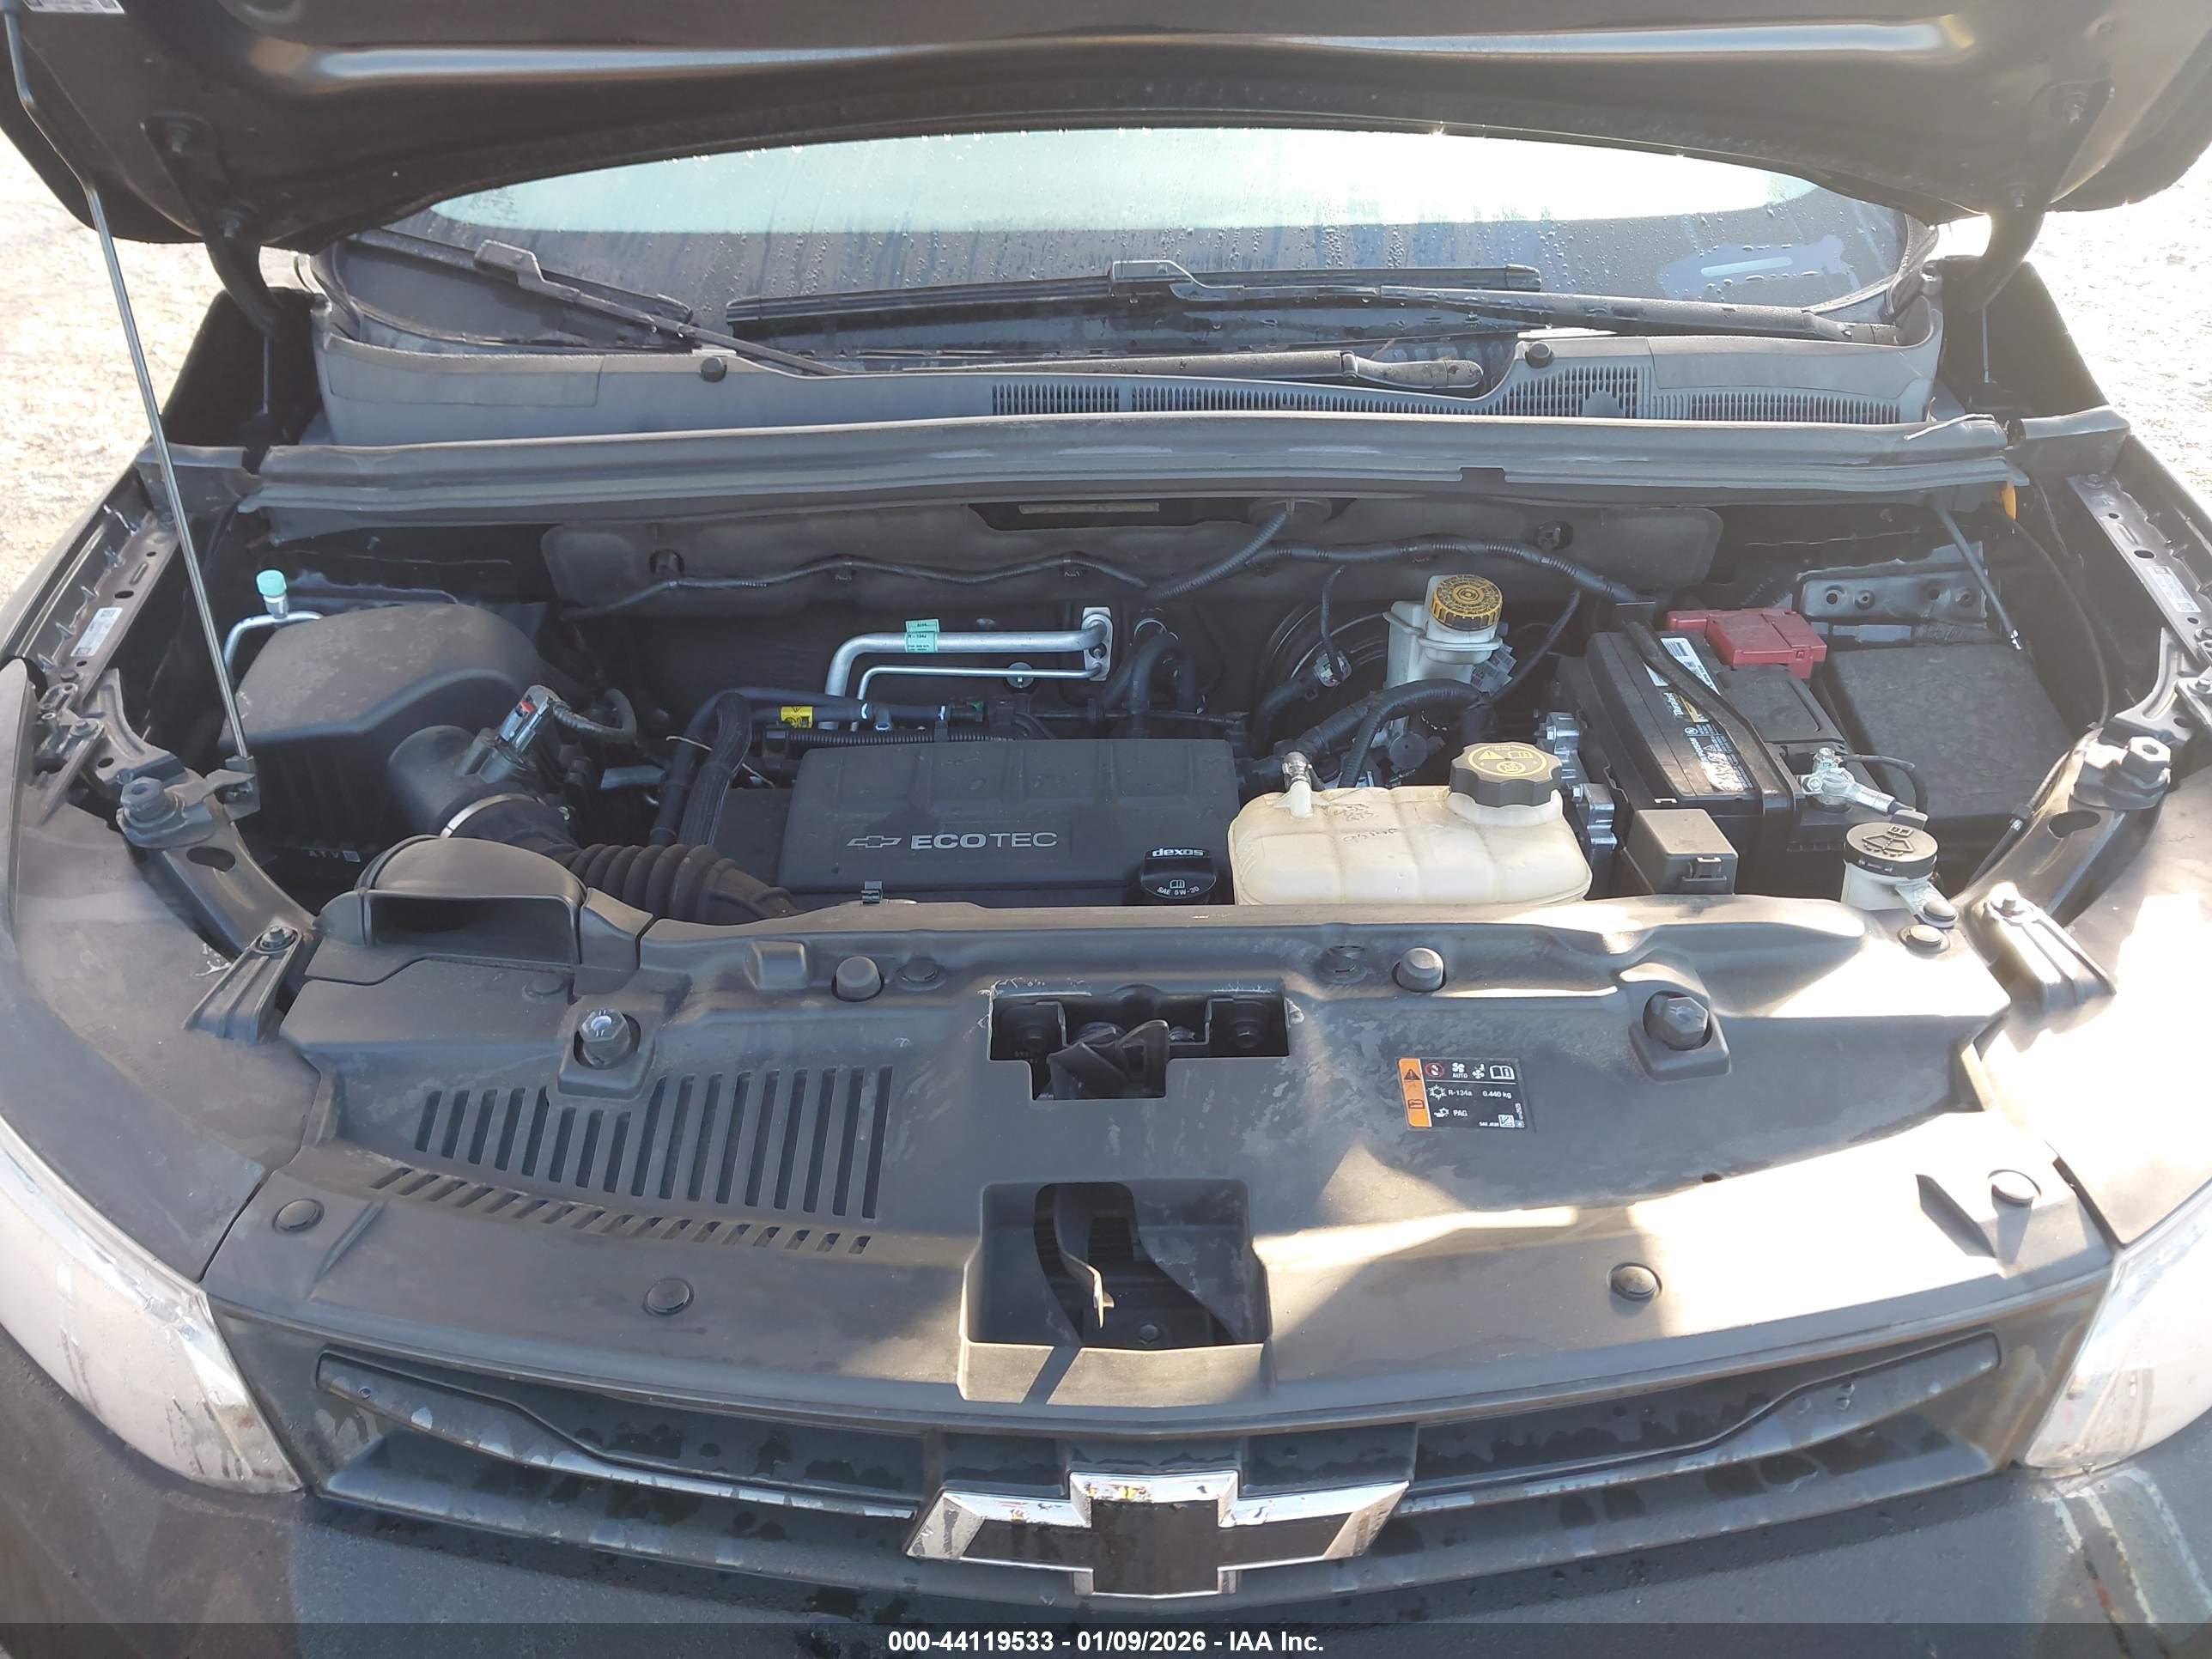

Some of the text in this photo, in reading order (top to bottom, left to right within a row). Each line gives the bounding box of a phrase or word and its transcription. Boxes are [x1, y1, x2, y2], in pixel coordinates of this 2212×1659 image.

[910, 832, 1057, 850] ECOTEC
[1152, 848, 1204, 857] dexos
[1157, 885, 1200, 896] SAE 5W-30
[1482, 1090, 1501, 1098] 0.440
[1503, 1091, 1512, 1099] kg
